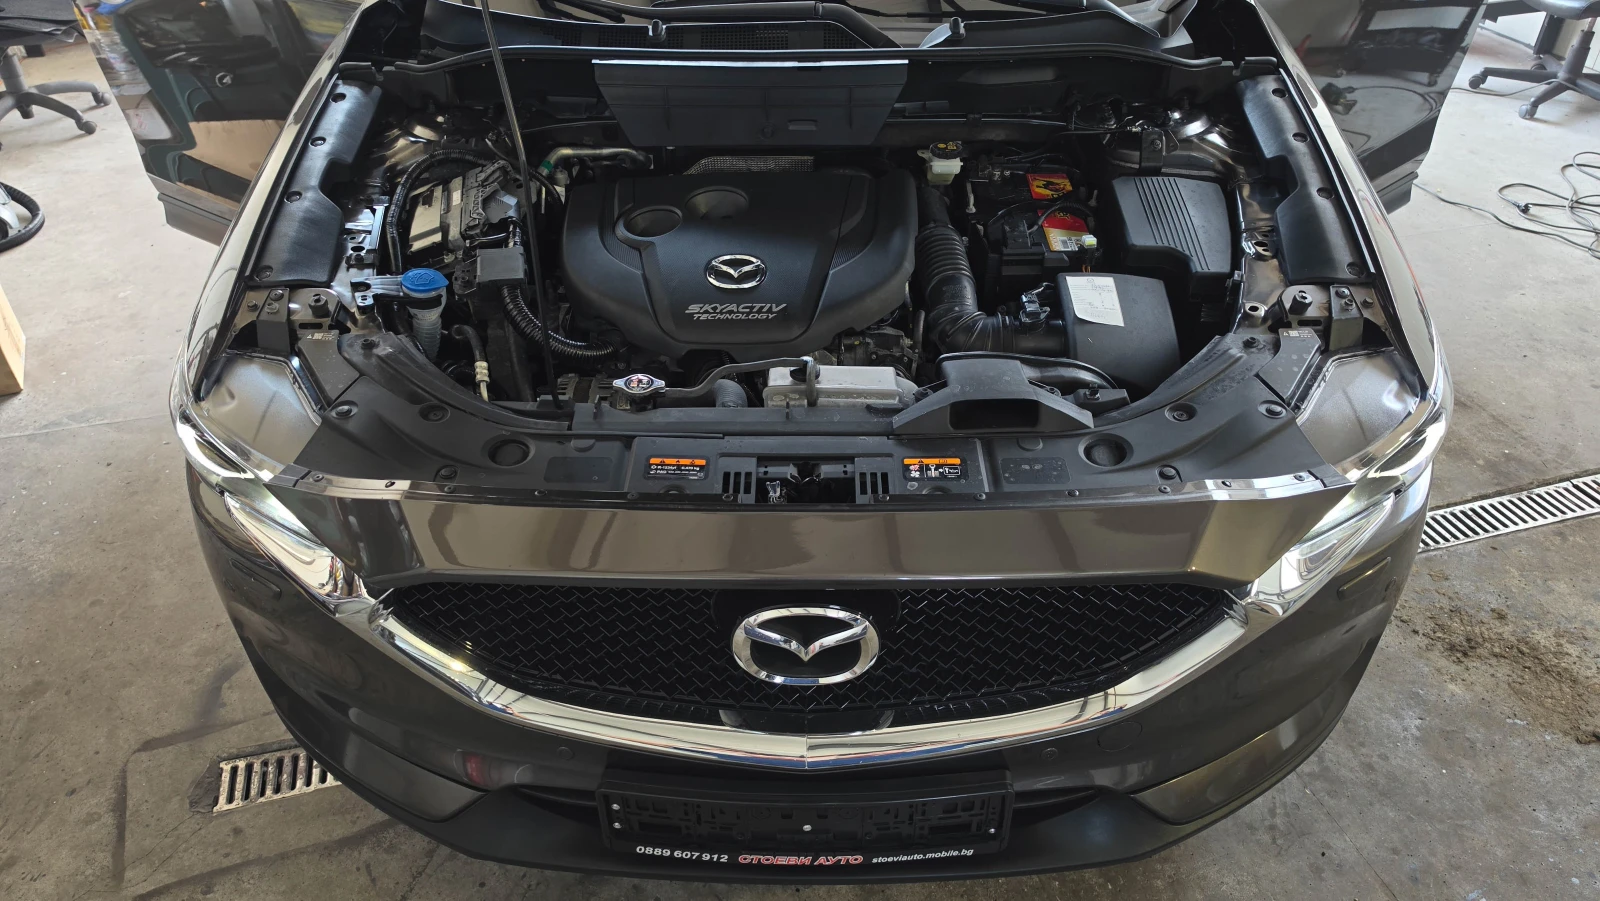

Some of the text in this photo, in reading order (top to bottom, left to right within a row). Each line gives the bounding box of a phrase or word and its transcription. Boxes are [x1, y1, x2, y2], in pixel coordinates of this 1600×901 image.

[685, 303, 787, 313] SKYACTIV
[635, 845, 974, 865] 0889 607 912 СТОЕВИ АУТО stoeviauto.mobile.bg
